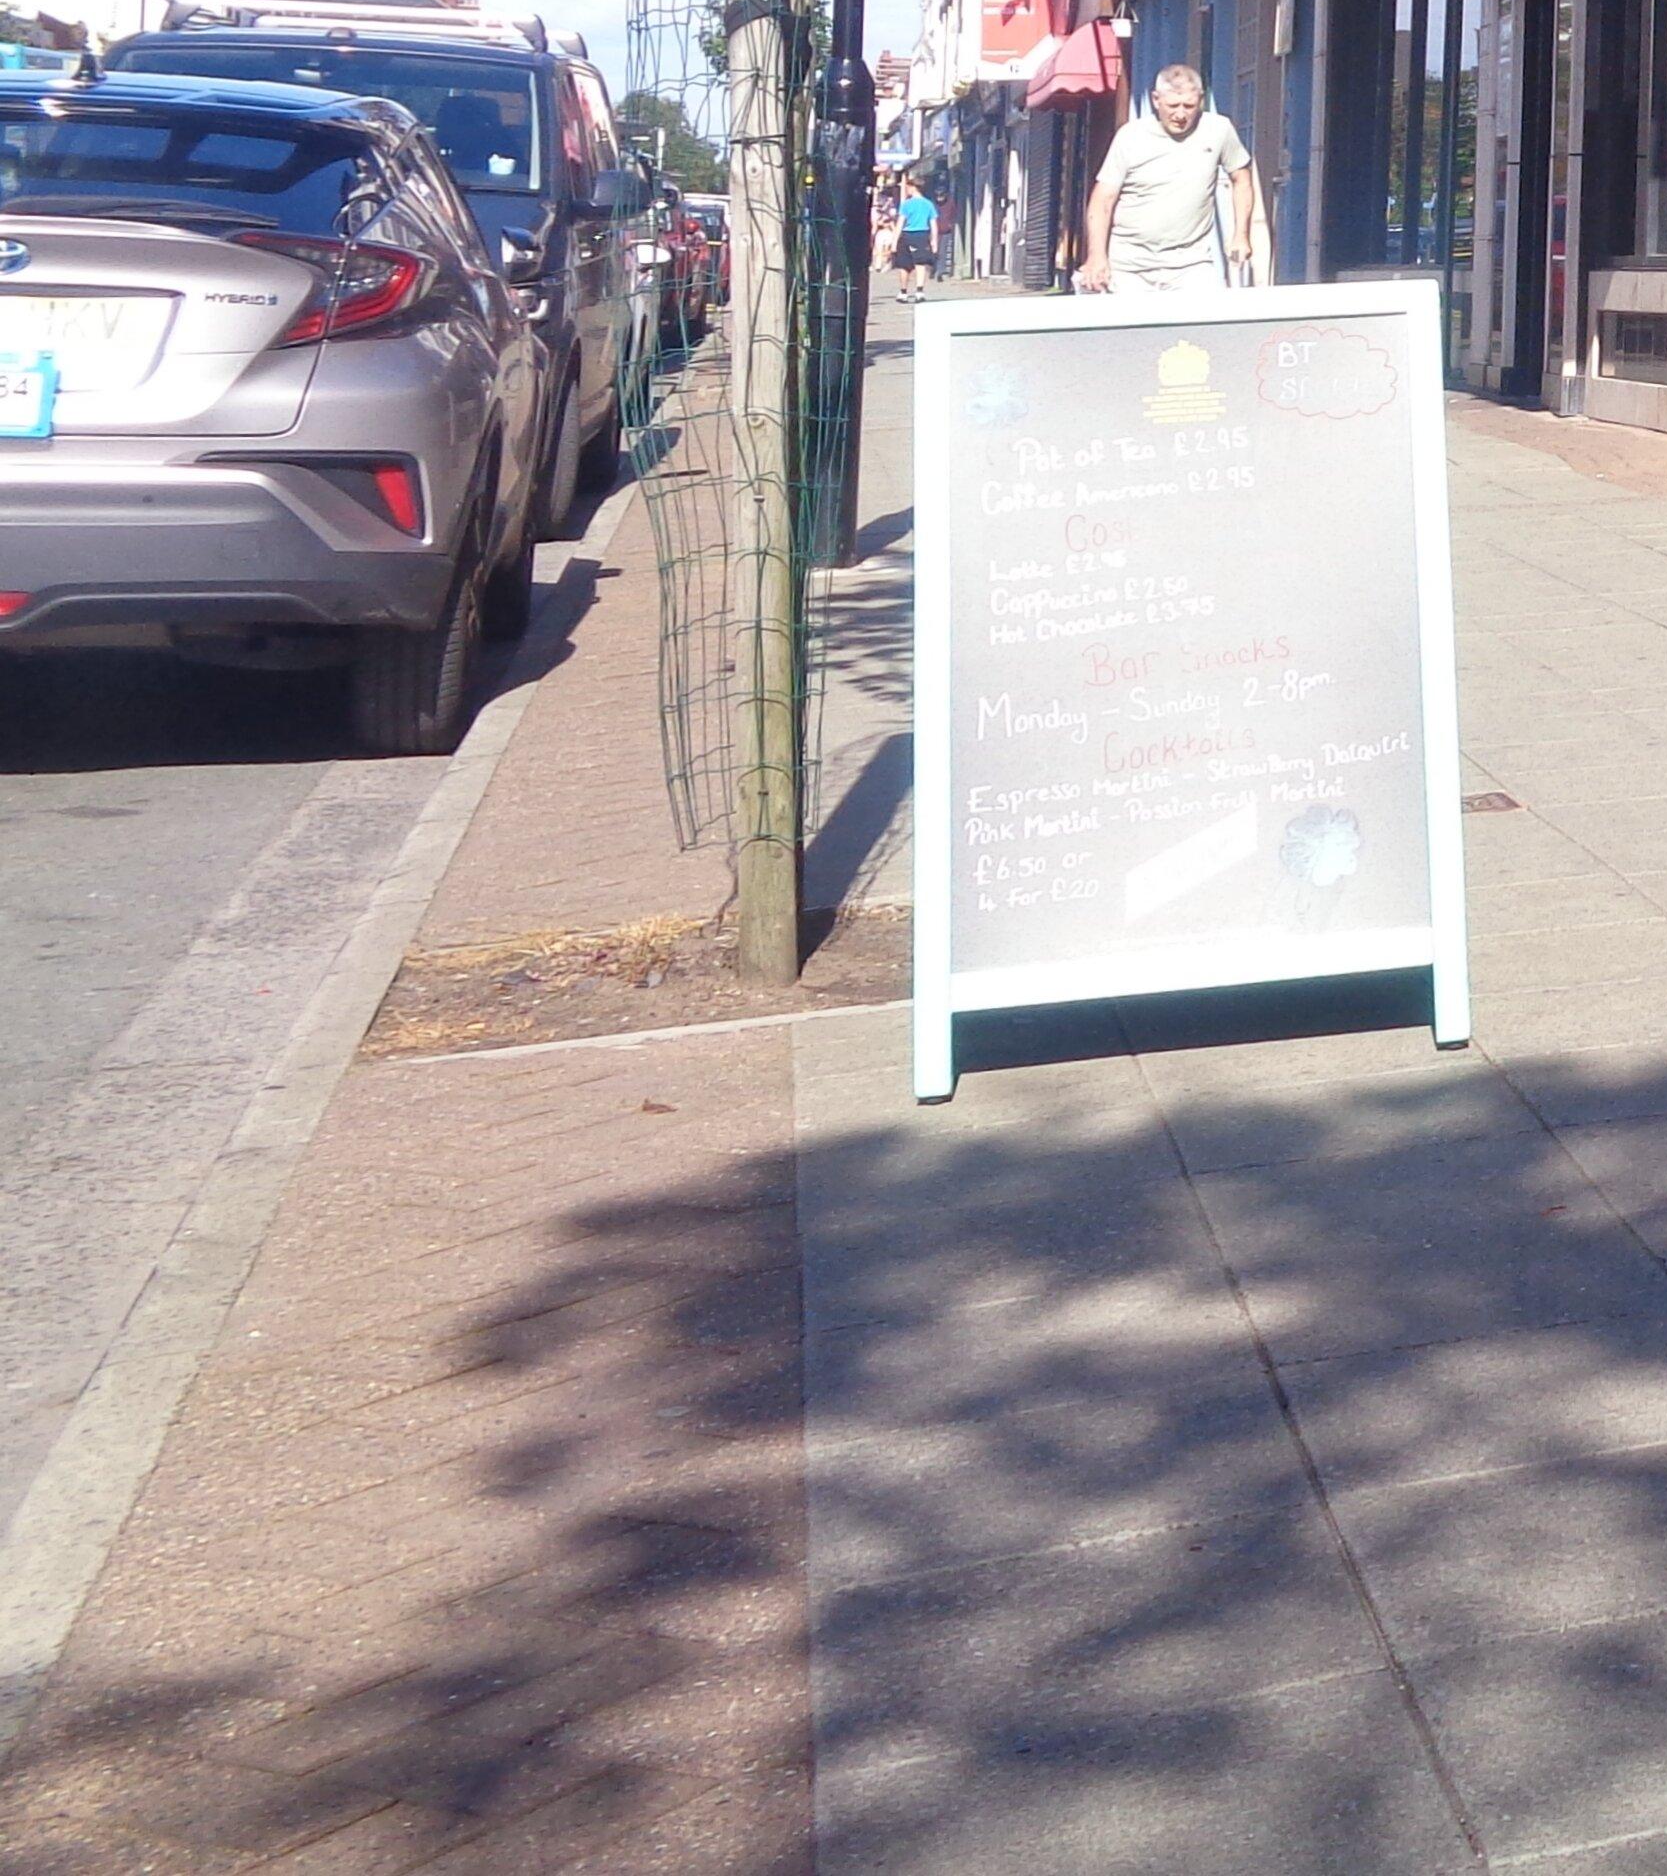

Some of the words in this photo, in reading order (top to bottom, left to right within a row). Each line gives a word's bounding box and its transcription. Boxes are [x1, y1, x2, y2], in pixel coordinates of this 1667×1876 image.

[204, 293, 267, 306] HYBRID
[1277, 340, 1319, 368] BT
[1012, 437, 1066, 476] Pot
[1073, 438, 1106, 467] of
[1111, 437, 1156, 462] Tea
[980, 480, 1066, 516] Coffee
[1075, 481, 1180, 508] Americano
[989, 559, 1054, 582] Latte
[990, 584, 1118, 620] Cappuccino
[989, 624, 1028, 646] Hot
[1036, 609, 1140, 641] Chocolate
[1080, 640, 1162, 688] Bar
[978, 692, 1089, 745] Monday
[1128, 685, 1222, 731] Sunday
[1102, 728, 1257, 776] Cocktails
[967, 782, 1082, 817] Espresso
[1092, 767, 1172, 796] Martini
[963, 816, 1015, 846] Pink
[1023, 805, 1102, 840] Martini
[1123, 795, 1202, 826] Passion
[1269, 775, 1346, 804] Martini
[973, 854, 1047, 886] £6.50
[1061, 851, 1091, 870] or
[978, 891, 999, 911] 4
[1050, 877, 1101, 903] £20
